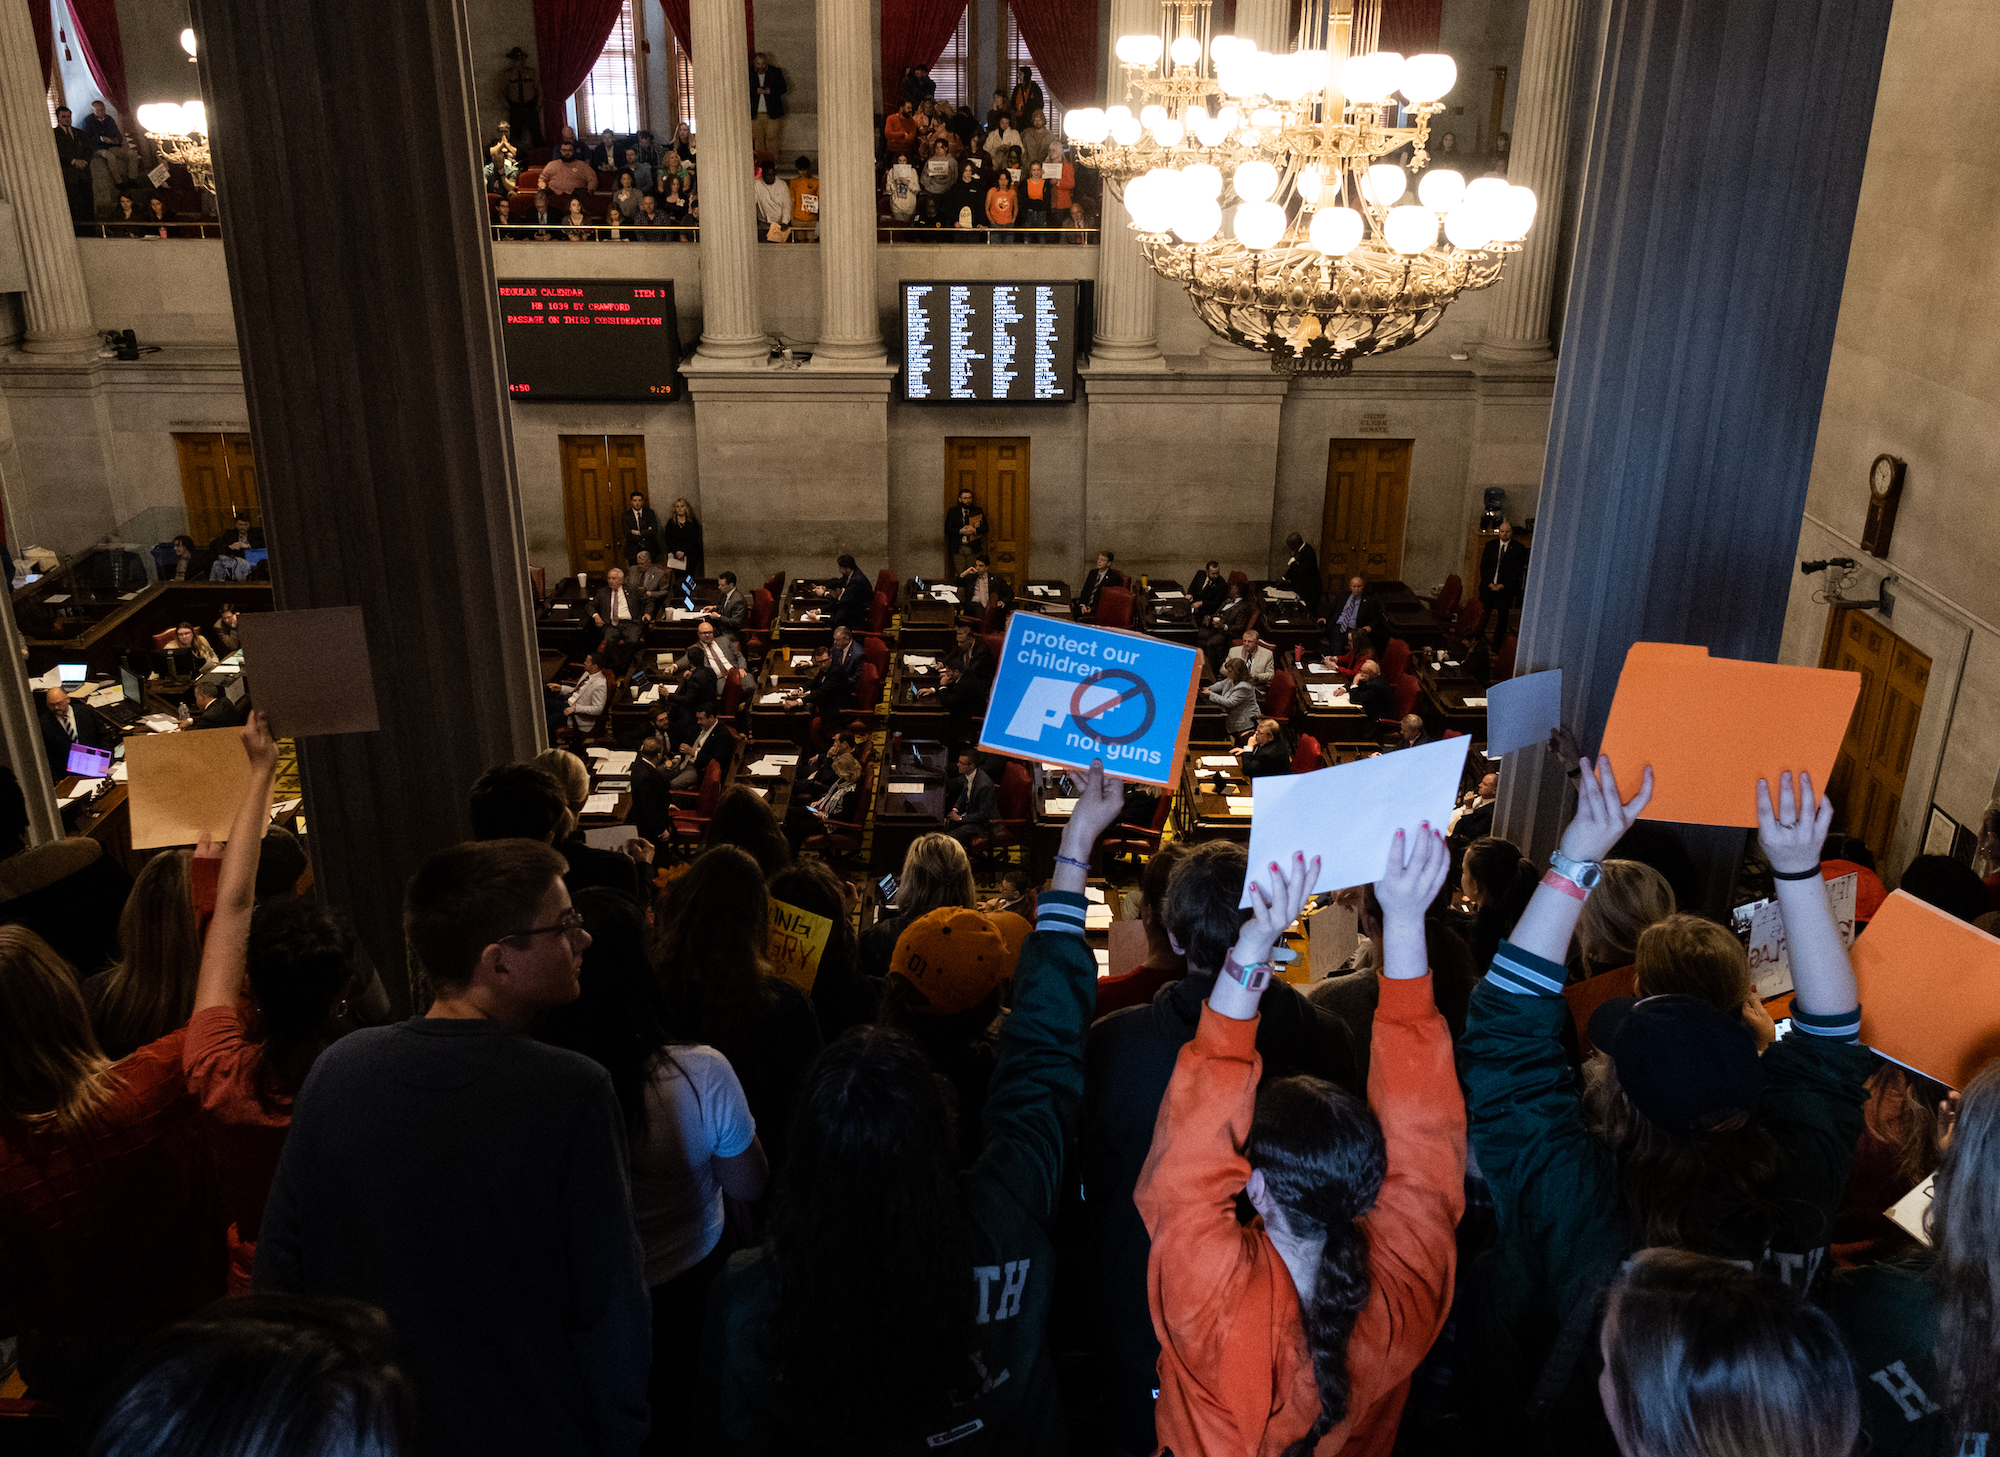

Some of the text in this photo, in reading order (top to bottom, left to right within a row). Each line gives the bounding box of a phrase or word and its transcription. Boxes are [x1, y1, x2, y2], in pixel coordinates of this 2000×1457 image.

[500, 288, 584, 297] REGULAR CALENDAR
[634, 289, 666, 298] ITEM 3
[508, 316, 662, 325] PASSAGE ON THIRD CONSIDERATION
[531, 302, 630, 312] HB 1039 BY CRAWFORD
[650, 386, 671, 394] 9:29
[1022, 630, 1140, 666] protect our
[1017, 648, 1103, 680] children
[1066, 732, 1162, 764] not guns
[770, 906, 811, 938] ING
[908, 954, 928, 978] 01
[974, 1258, 1030, 1324] TH
[1869, 1360, 1940, 1422] H
